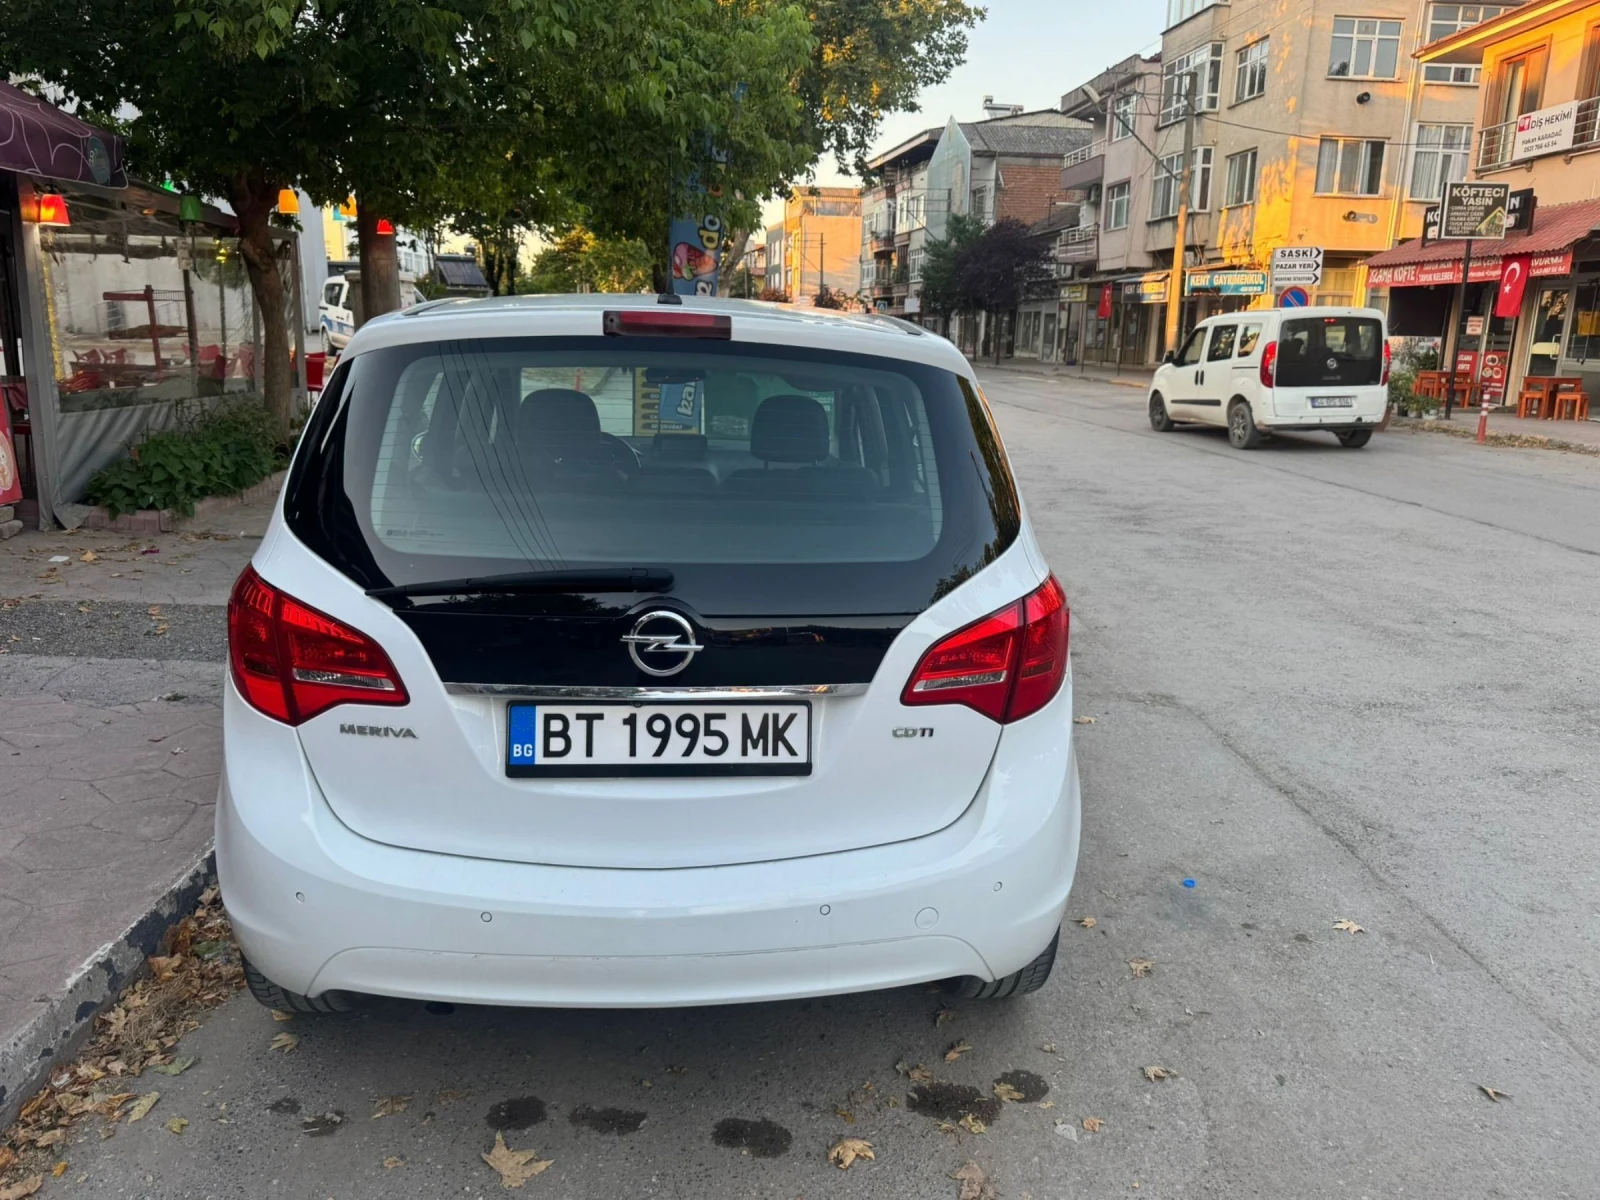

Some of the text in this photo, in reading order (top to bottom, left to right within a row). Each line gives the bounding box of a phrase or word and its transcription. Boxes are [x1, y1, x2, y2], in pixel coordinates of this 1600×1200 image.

[1531, 108, 1573, 129] DİŞ HEKİMİ
[1191, 275, 1210, 286] KENT
[340, 723, 419, 739] MERIVA
[543, 712, 799, 758] BT 1995 MK
[513, 743, 533, 757] BG
